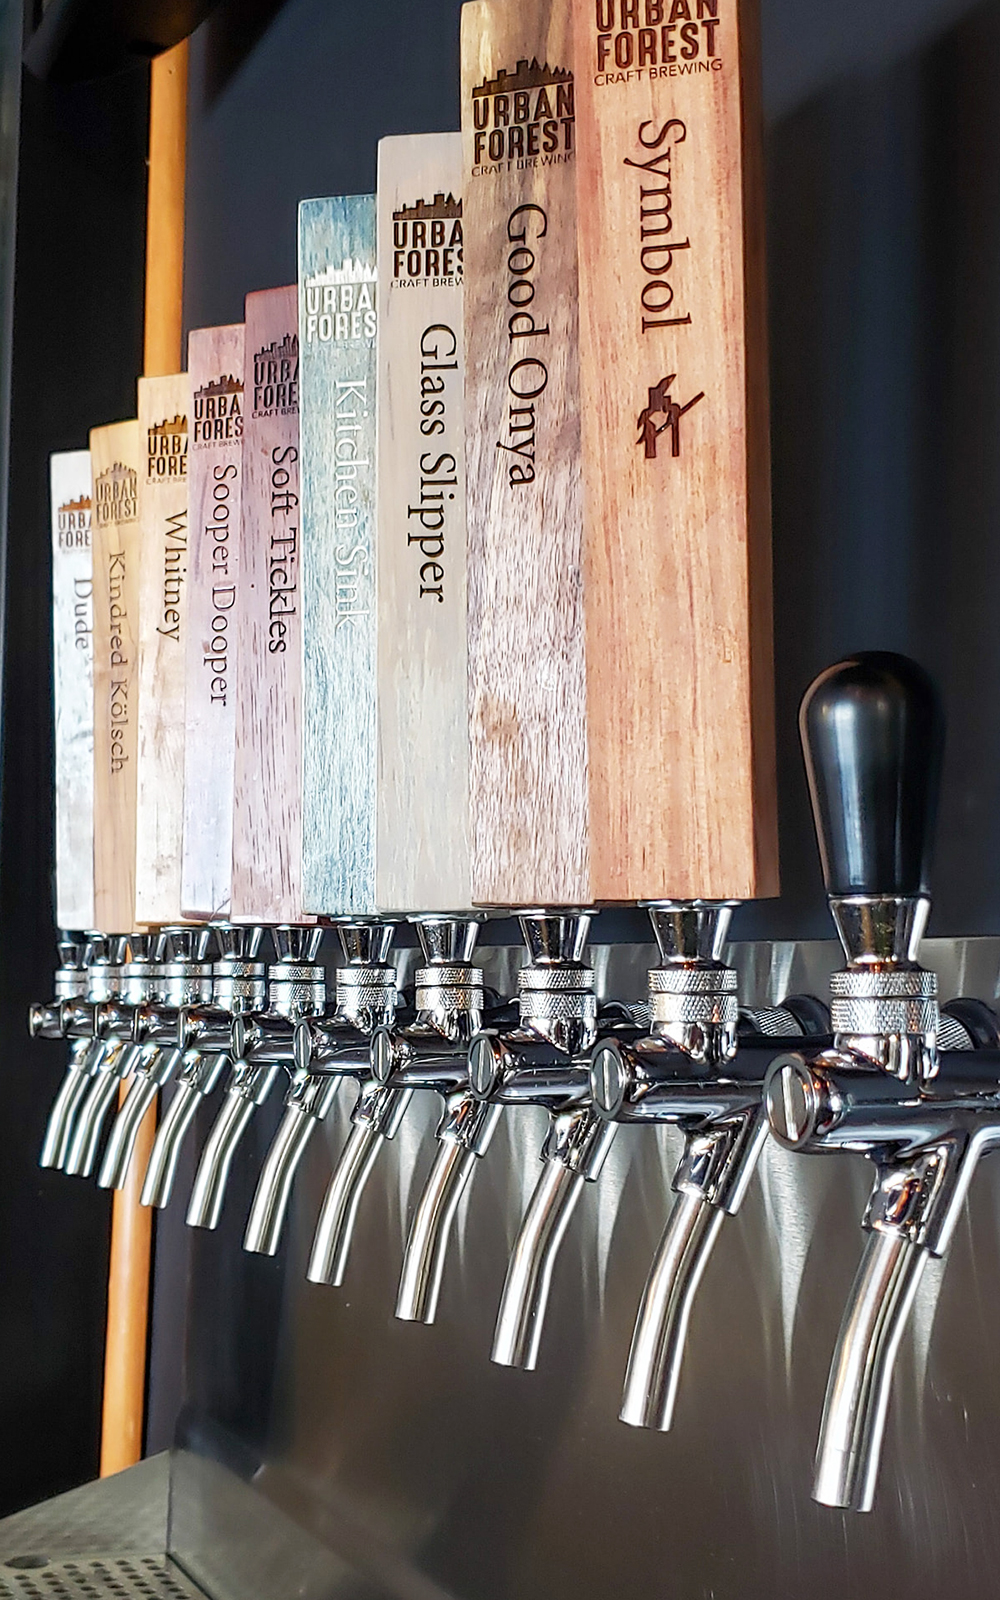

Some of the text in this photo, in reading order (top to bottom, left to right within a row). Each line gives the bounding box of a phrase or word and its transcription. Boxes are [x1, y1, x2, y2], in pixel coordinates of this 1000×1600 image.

[594, 58, 723, 87] CRAFT BREWING
[598, 19, 720, 72] FOREST
[473, 83, 574, 130] URBAN
[471, 161, 513, 177] CRAFT
[475, 117, 575, 164] FOREST
[623, 118, 691, 334] Symbol
[390, 279, 429, 289] CRAFT
[306, 310, 377, 343] FORES
[496, 203, 550, 489] Good Onya
[252, 409, 278, 419] CRAFT
[192, 441, 216, 451] CRAFT
[335, 379, 370, 530] Kitchen
[408, 323, 459, 603] Glass Slipper
[95, 475, 137, 502] URBAN
[96, 498, 137, 524] FOREST
[156, 509, 188, 643] Whitney
[268, 446, 299, 654] Soft Tickles
[74, 577, 93, 650] Dude
[109, 551, 127, 668] Kindred
[203, 464, 237, 707] Sooper Dooper
[335, 544, 370, 634] Sink
[110, 679, 129, 774] Kölsch
